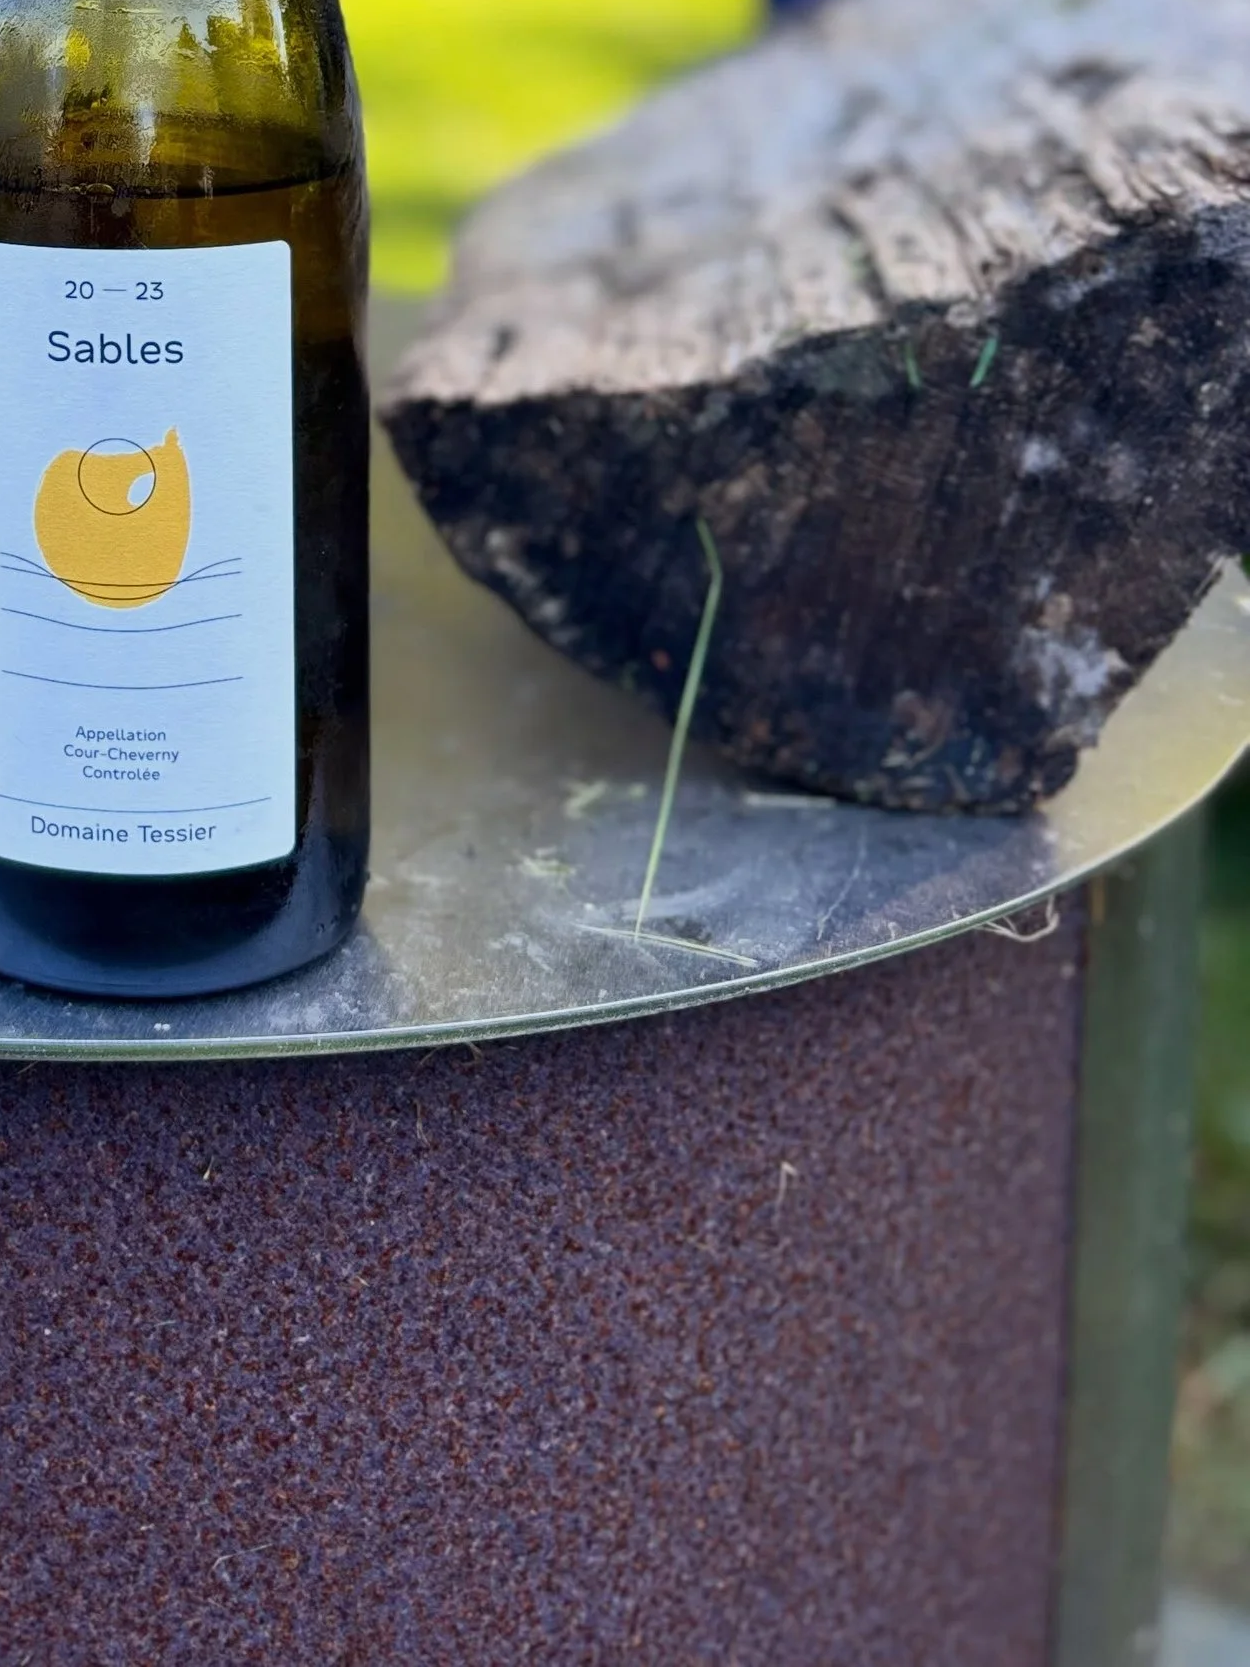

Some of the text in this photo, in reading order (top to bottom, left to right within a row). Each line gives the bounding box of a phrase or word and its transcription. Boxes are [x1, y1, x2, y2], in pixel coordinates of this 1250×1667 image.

[64, 280, 94, 299] 20
[135, 281, 164, 300] 23
[47, 330, 184, 364] Sables
[75, 725, 167, 742] Appellation
[63, 744, 180, 764] Cour-Cheverny
[30, 815, 217, 843] Domaine Tessier
